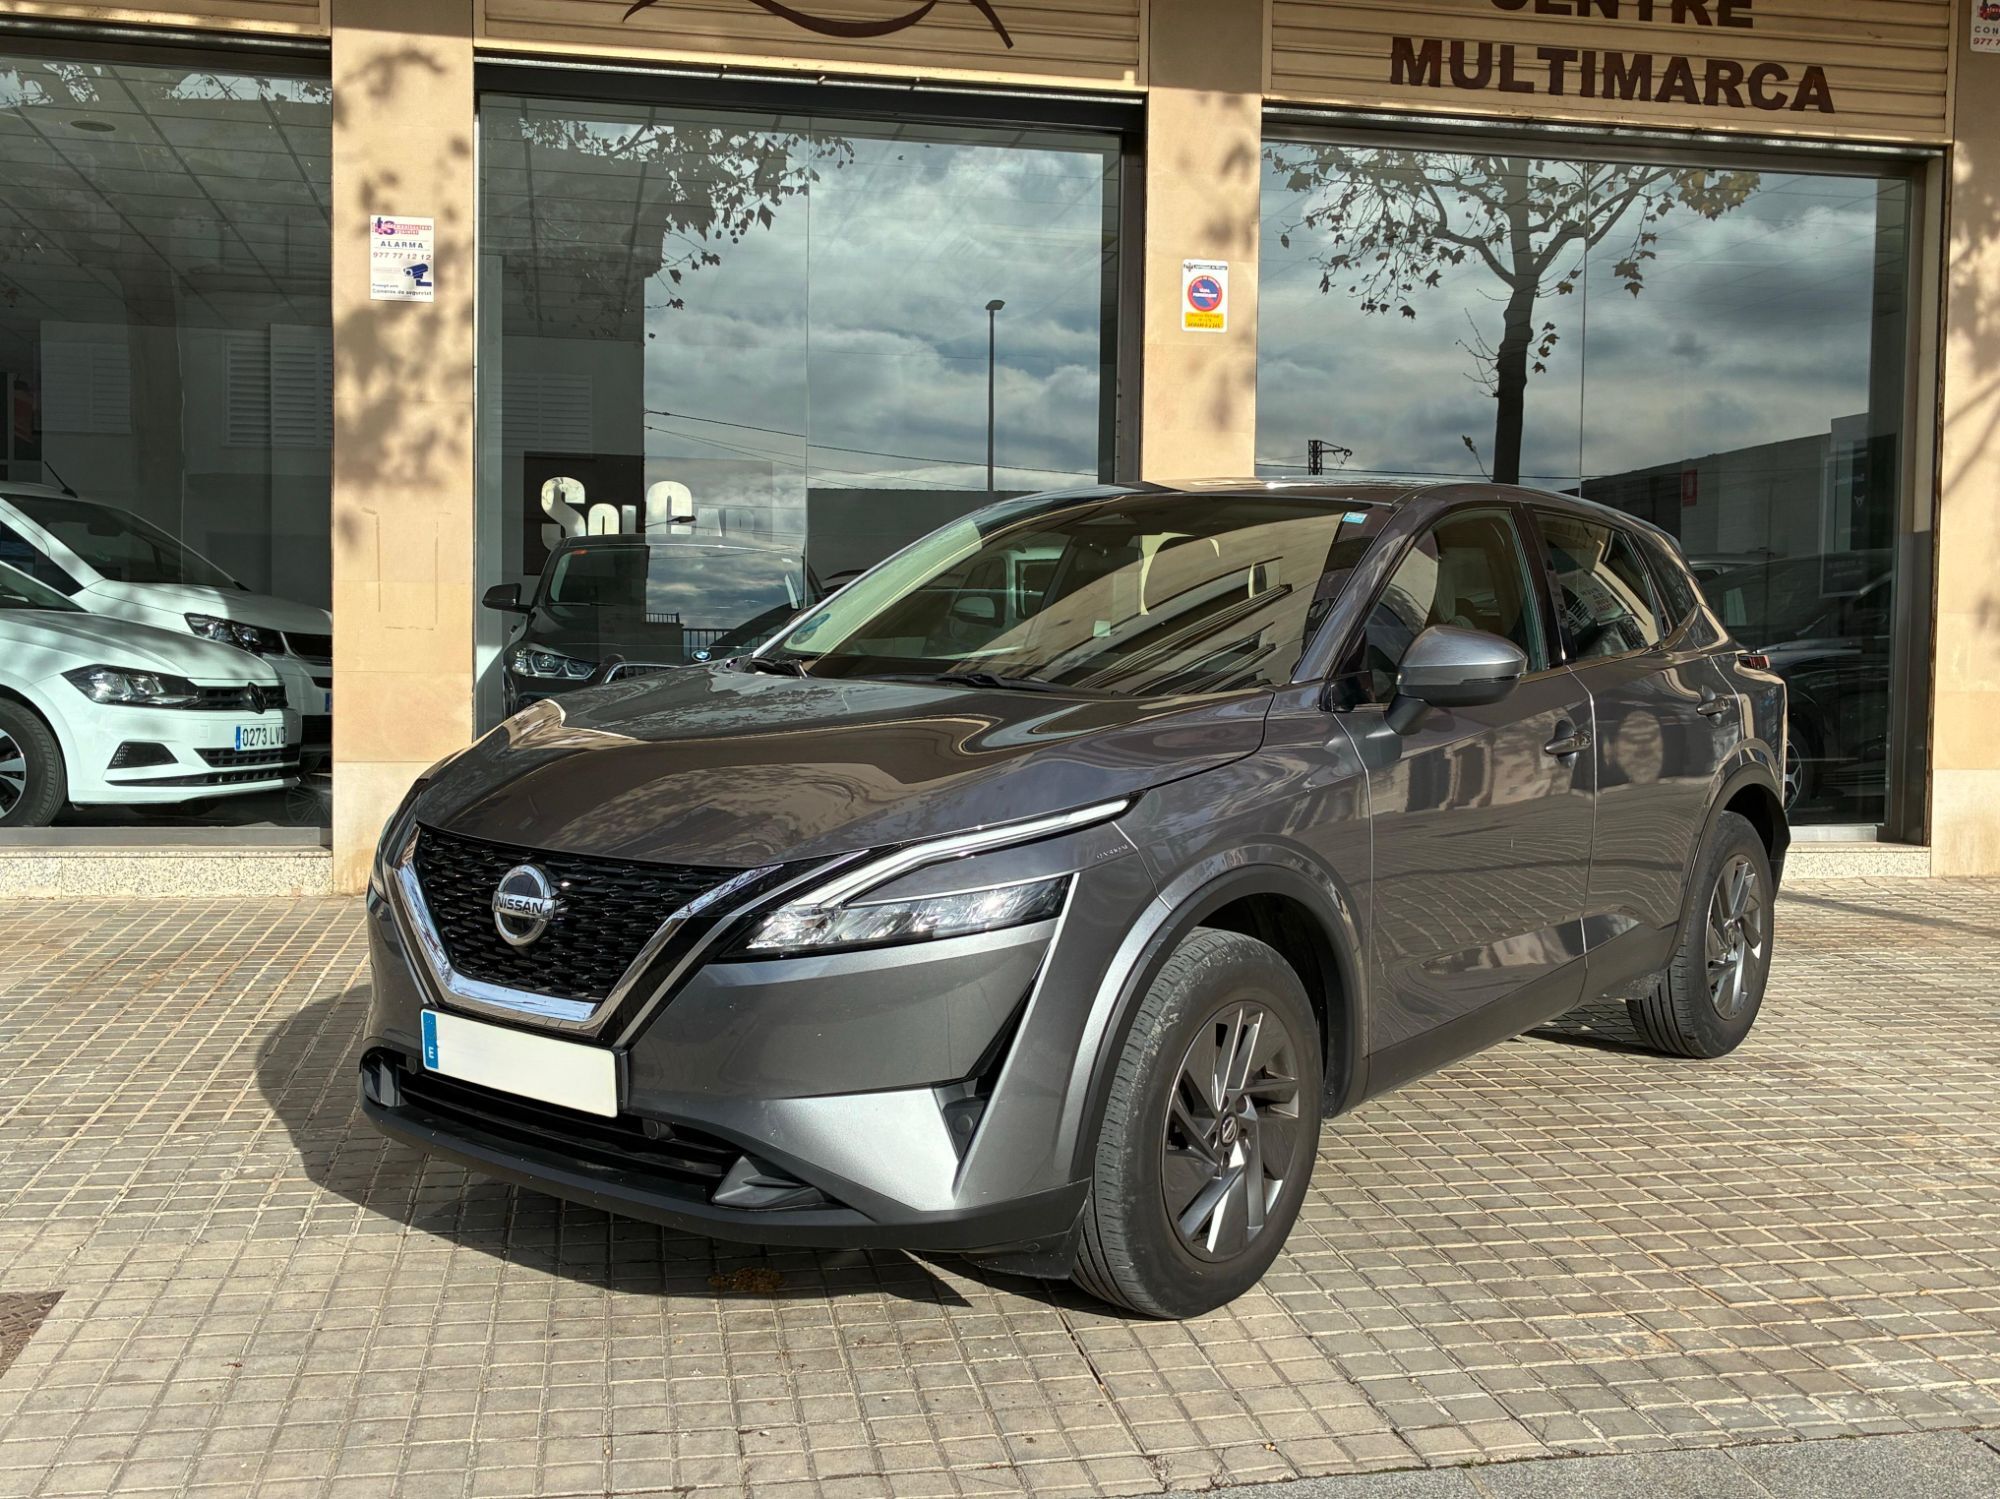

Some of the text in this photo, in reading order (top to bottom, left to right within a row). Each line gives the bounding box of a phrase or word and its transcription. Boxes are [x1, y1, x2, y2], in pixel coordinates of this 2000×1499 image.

[1390, 36, 1836, 114] MULTIMARCA
[380, 240, 424, 249] ALARMA
[373, 251, 390, 259] 977
[393, 252, 404, 260] 77
[242, 727, 287, 747] 0273 LVD
[496, 896, 543, 914] NISSAN
[427, 1046, 435, 1059] E
